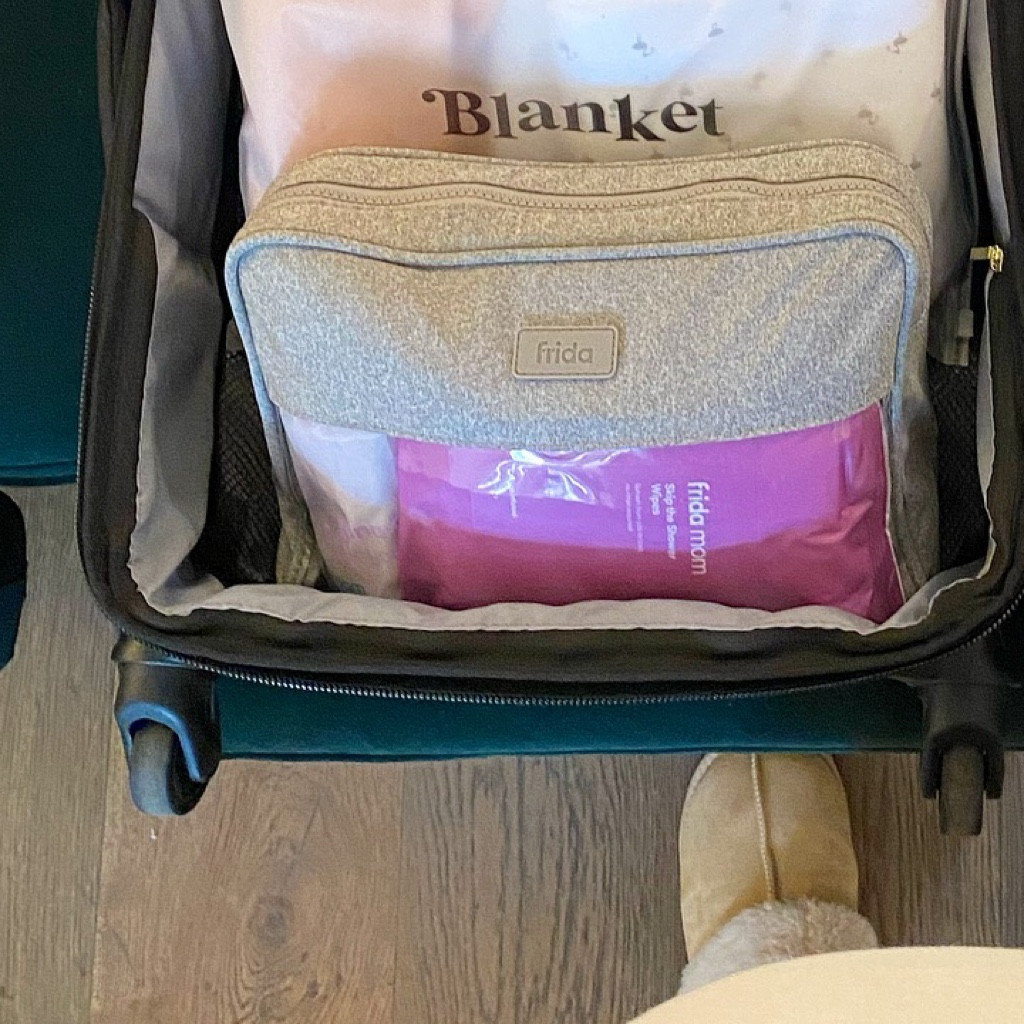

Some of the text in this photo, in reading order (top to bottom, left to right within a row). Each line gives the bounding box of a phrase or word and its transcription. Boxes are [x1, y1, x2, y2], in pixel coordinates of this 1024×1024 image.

[422, 86, 725, 143] Blanket
[536, 340, 594, 365] frida
[649, 482, 662, 516] Wipes
[664, 482, 678, 560] Skip the Shower
[687, 481, 711, 576] frida mom
